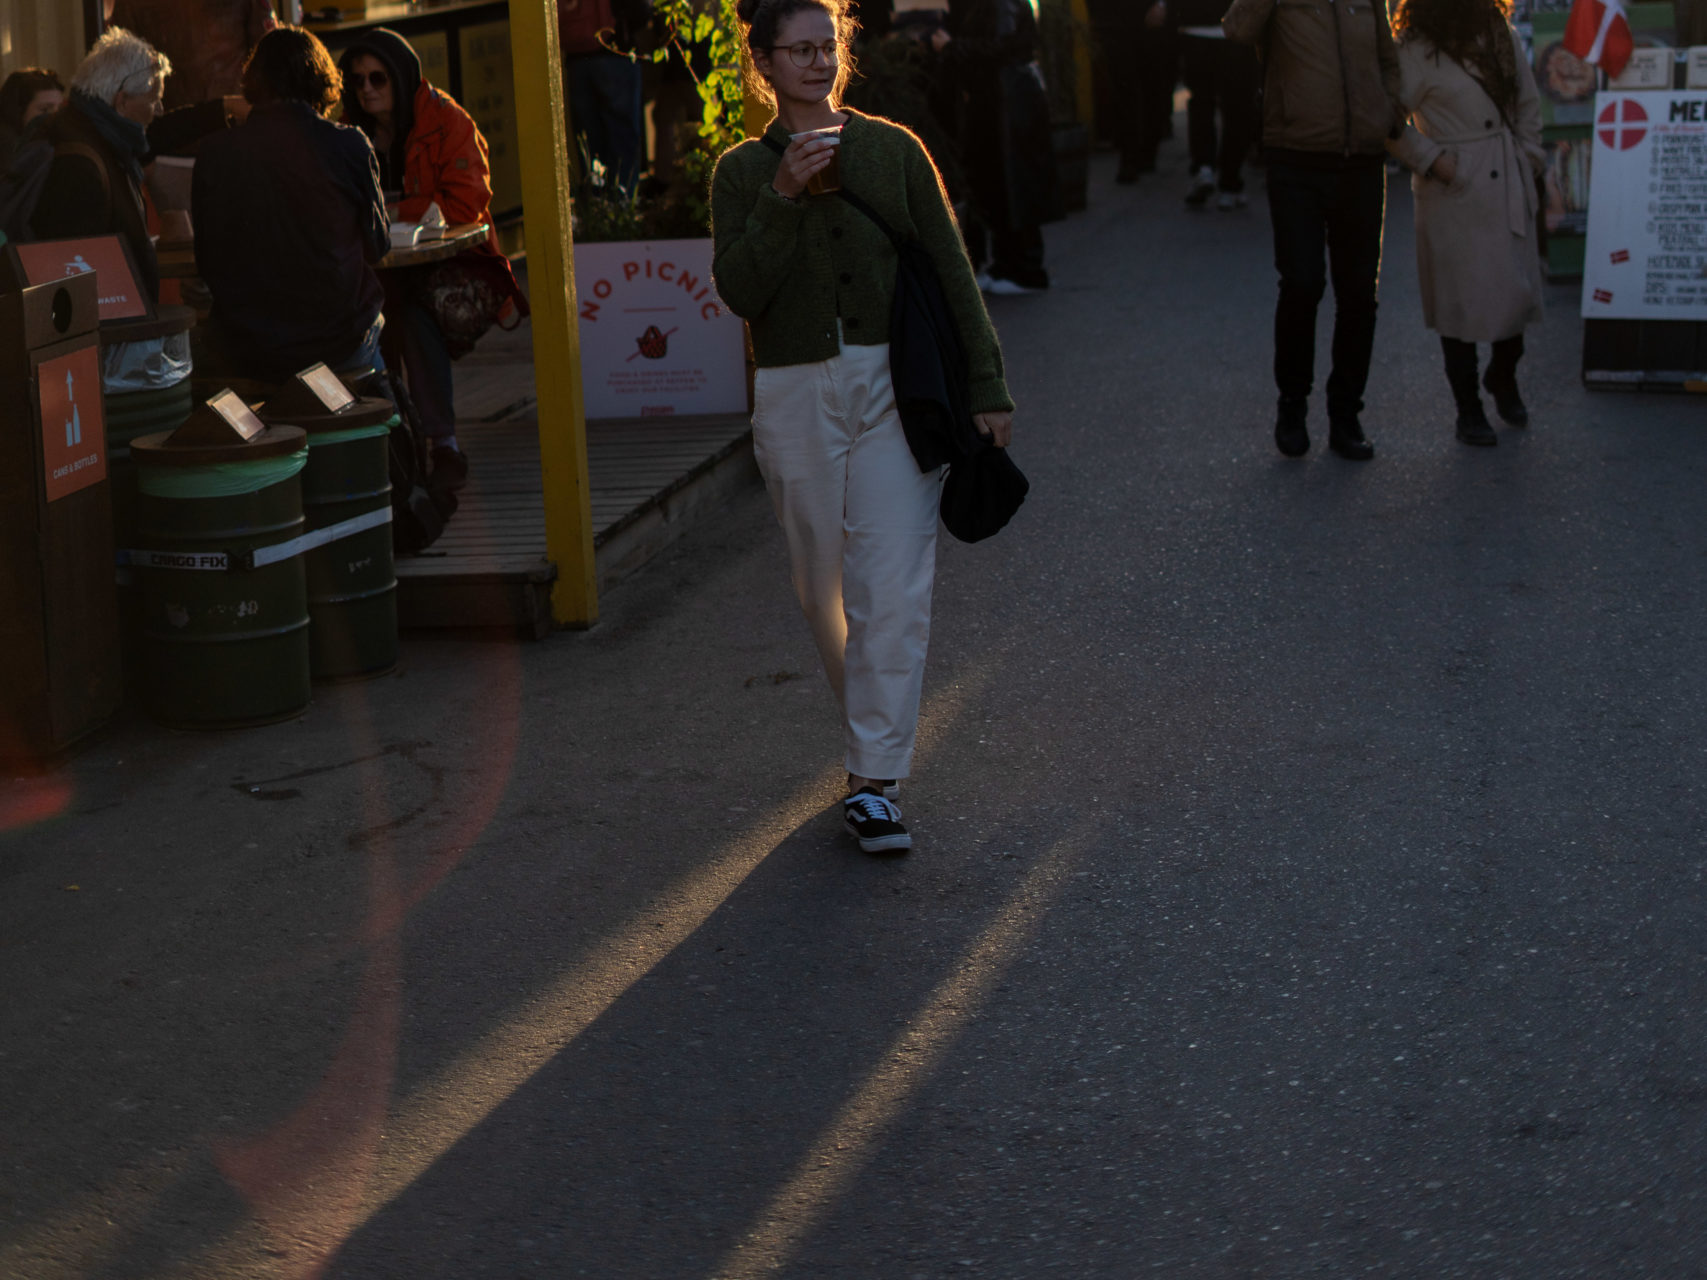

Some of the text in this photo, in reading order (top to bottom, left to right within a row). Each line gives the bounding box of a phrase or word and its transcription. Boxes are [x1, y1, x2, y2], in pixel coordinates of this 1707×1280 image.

[1670, 101, 1707, 122] ME
[580, 259, 721, 322] NO PICNIC
[53, 464, 69, 480] CANS
[74, 453, 98, 471] BOTTLES
[152, 554, 226, 568] CARGO FIX
